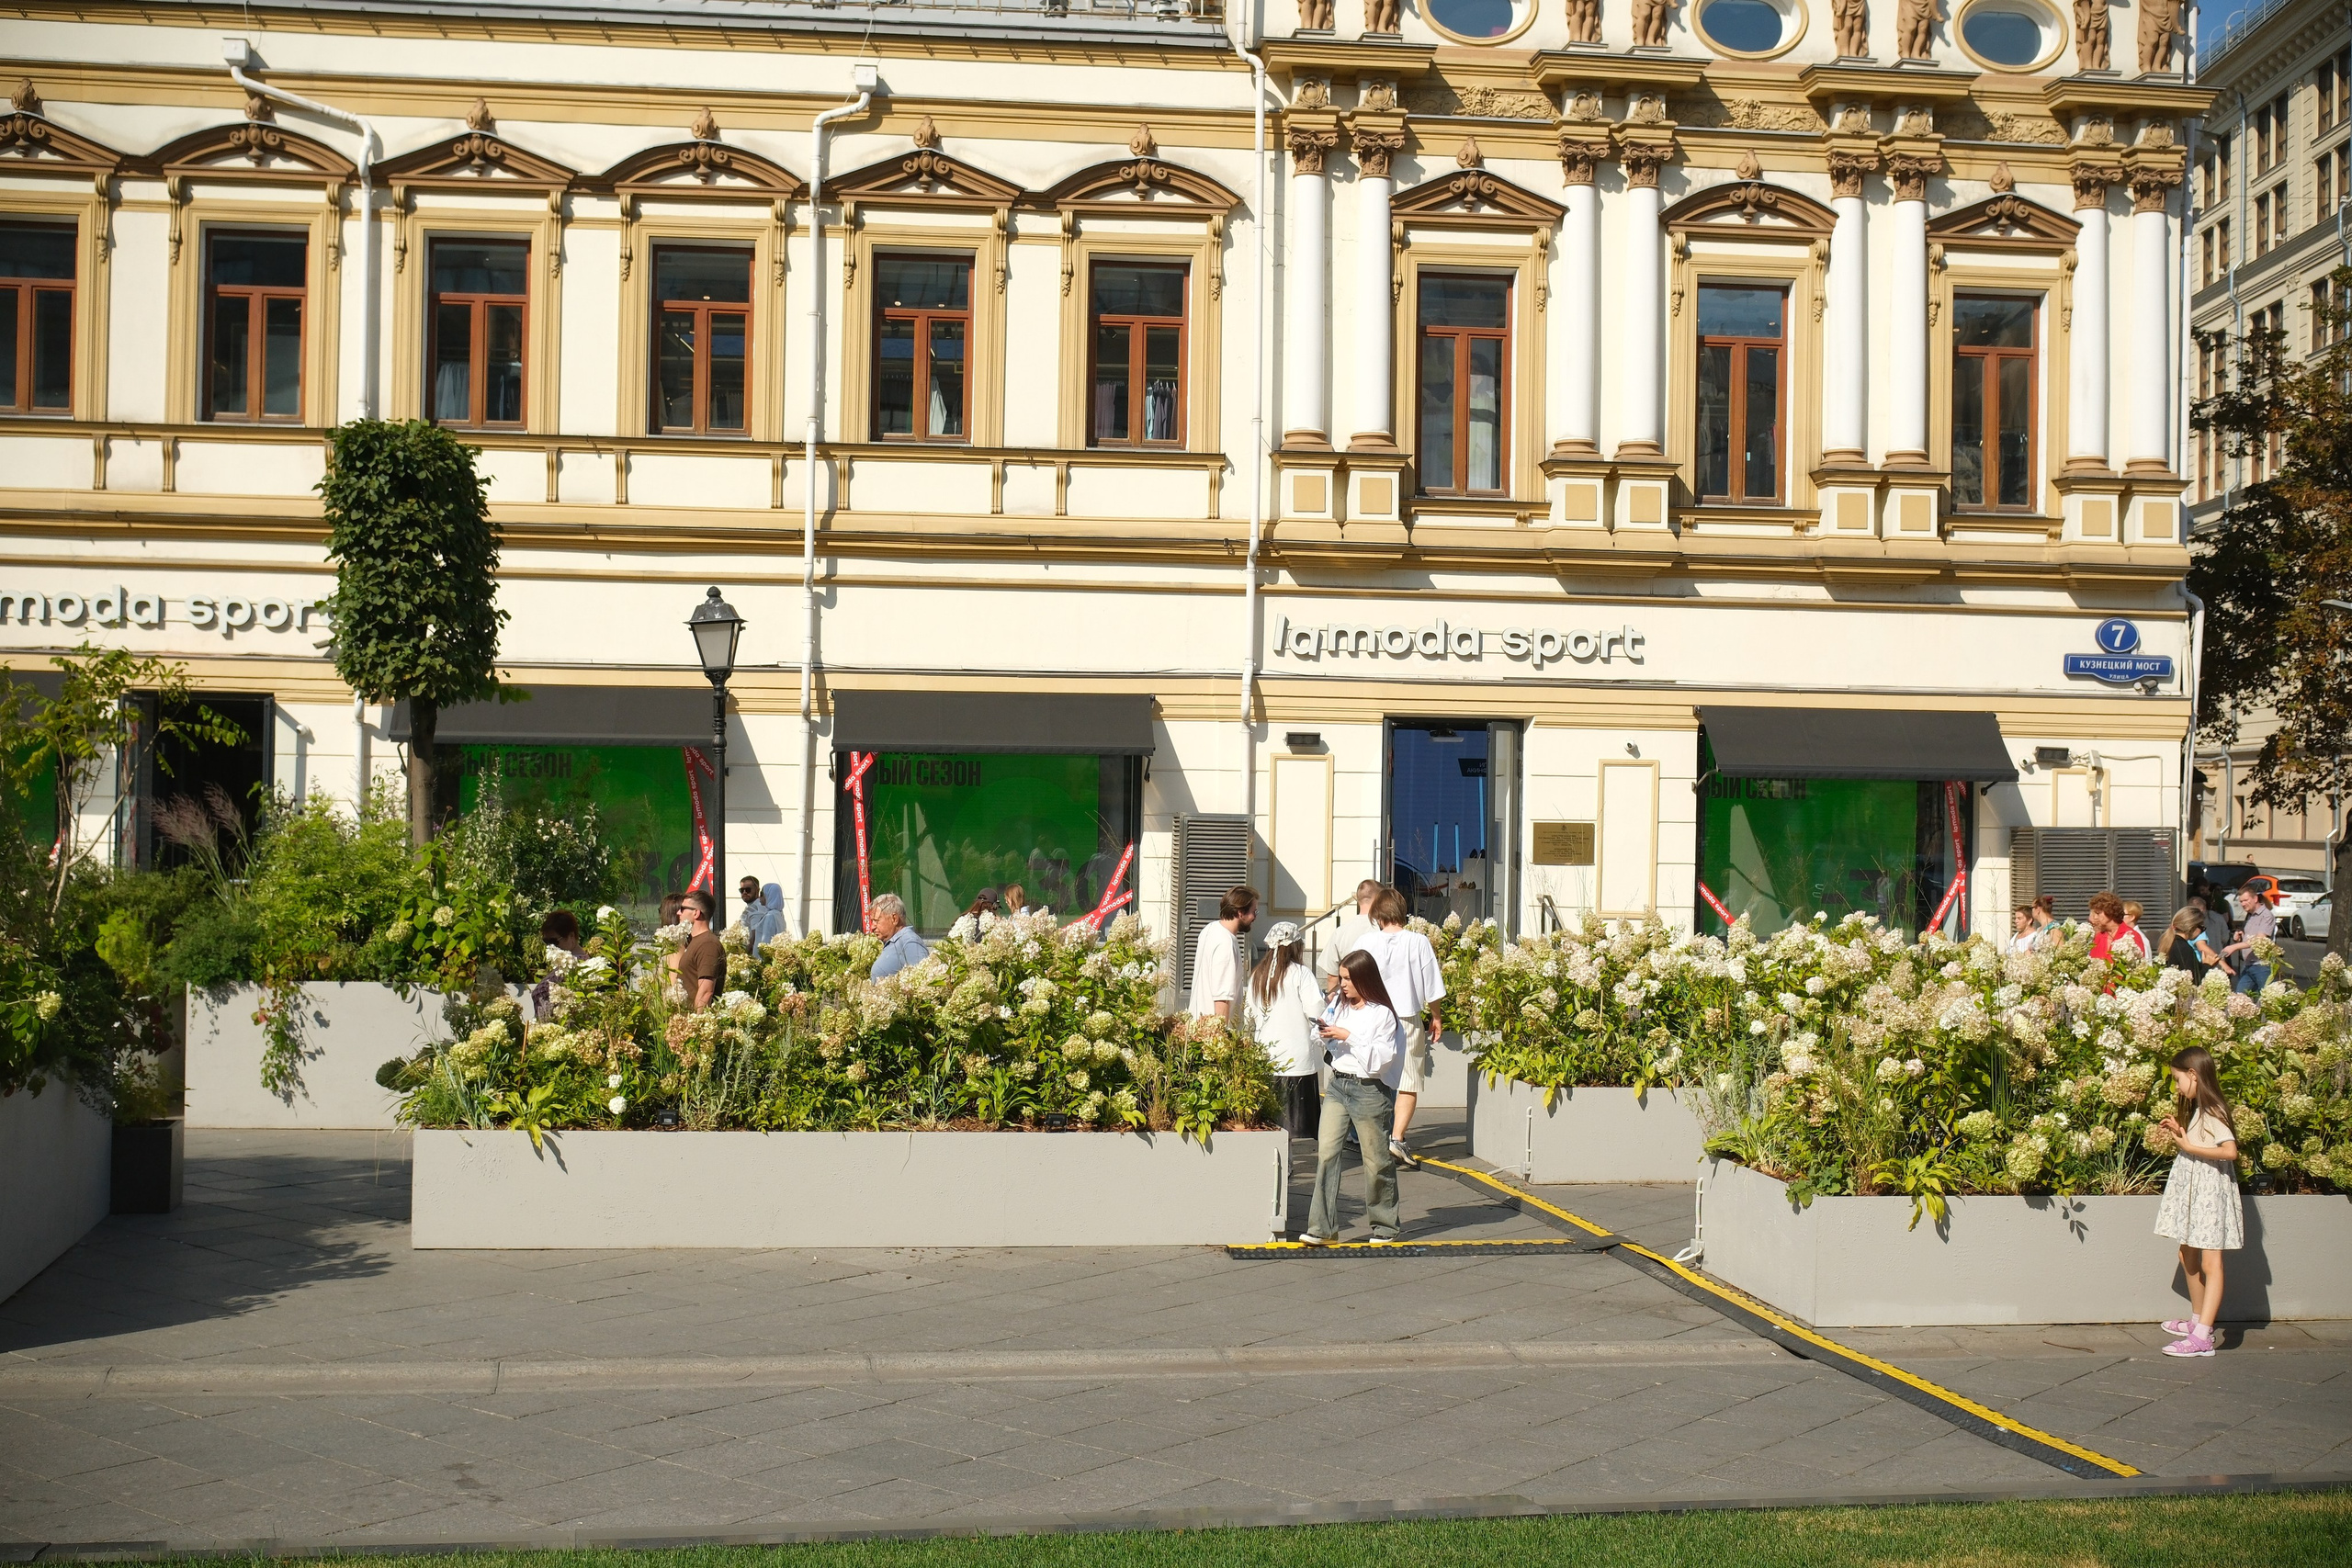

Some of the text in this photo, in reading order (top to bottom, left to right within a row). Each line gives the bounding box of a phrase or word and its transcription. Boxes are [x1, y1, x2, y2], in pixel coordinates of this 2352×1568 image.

[1273, 613, 1643, 666] lamoda sport
[2111, 625, 2126, 648] 7
[2079, 660, 2161, 671] КУЗНЕЦКИЙ МОСТ
[504, 751, 571, 779] СЕЗОН
[699, 758, 714, 775] sport
[854, 759, 870, 776] sport
[916, 760, 981, 786] СЕЗОН
[688, 770, 697, 790] sport
[855, 803, 864, 823] sport
[1946, 785, 1959, 833] lamoda sport
[857, 829, 865, 857] lamoda
[1954, 839, 1962, 858] sport
[692, 861, 708, 887] lamoda
[1111, 859, 1127, 886] lamoda
[1099, 897, 1125, 915] lamoda
[1714, 903, 1729, 919] sport
[1934, 878, 1961, 921] lamoda sport
